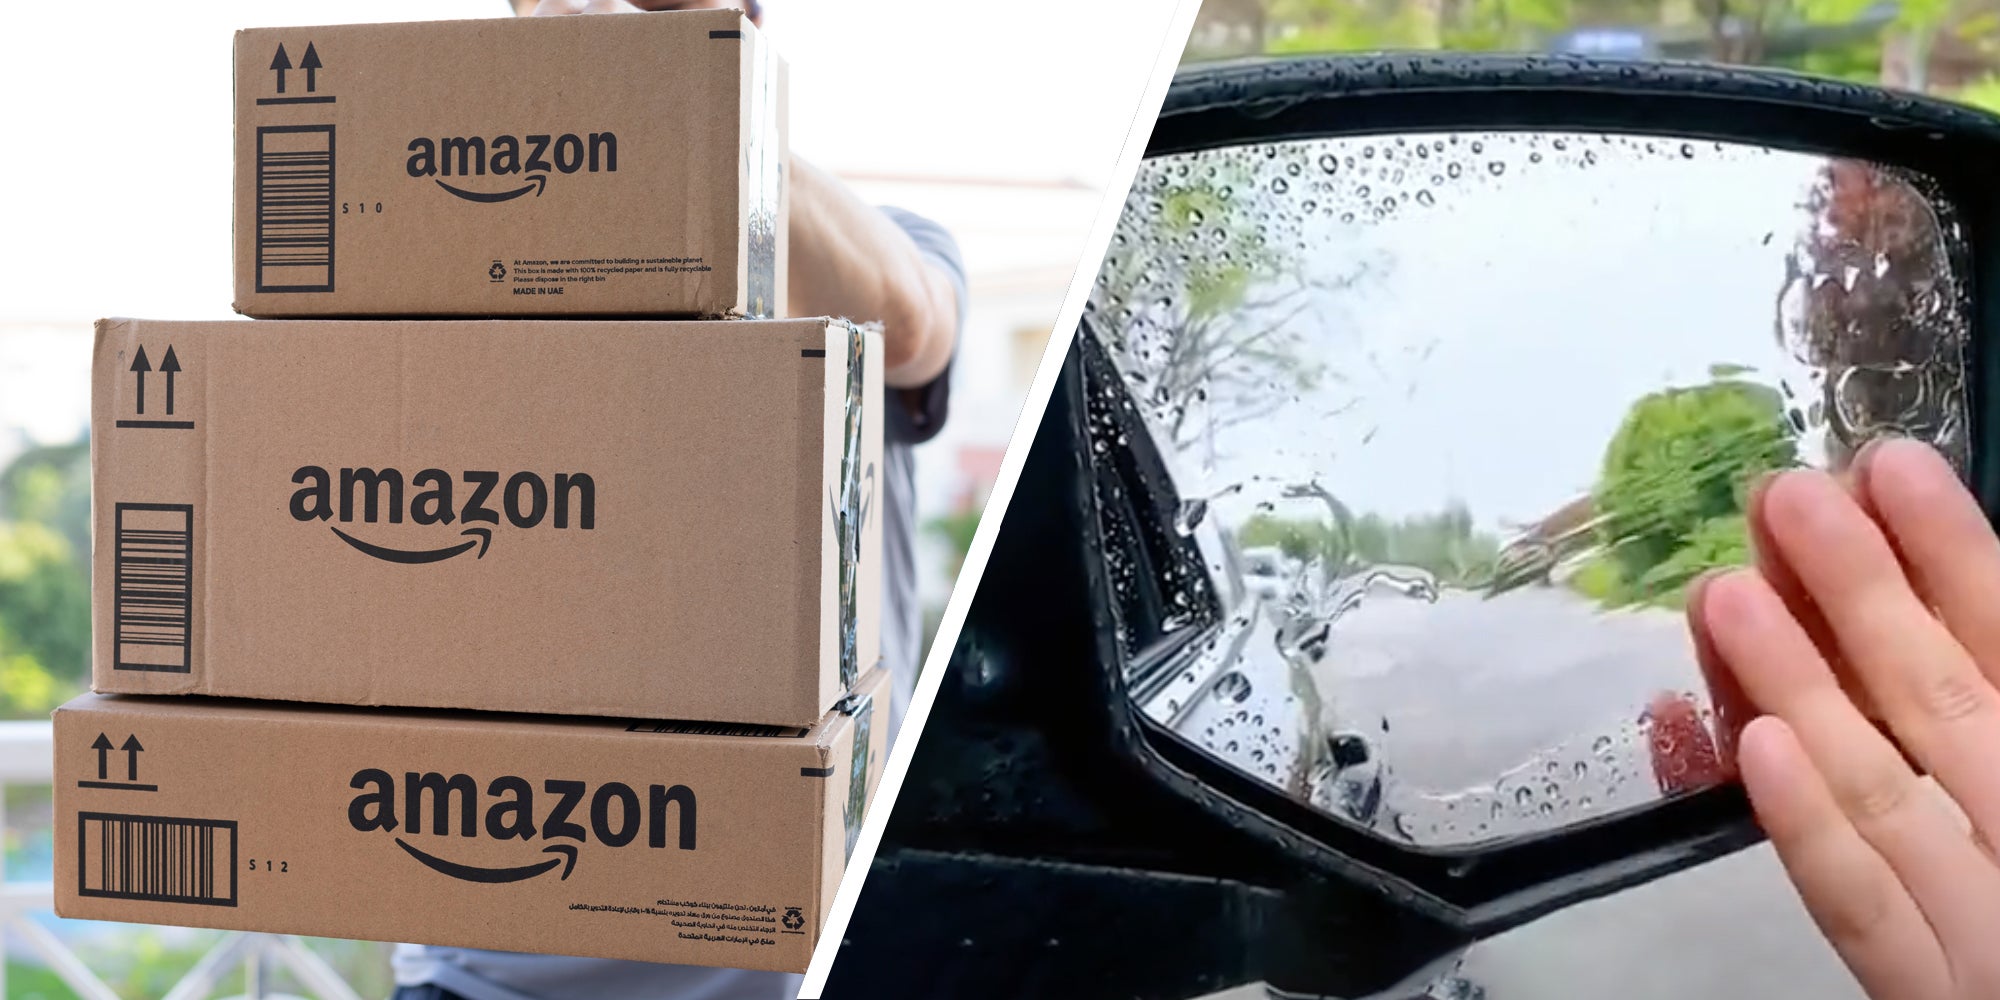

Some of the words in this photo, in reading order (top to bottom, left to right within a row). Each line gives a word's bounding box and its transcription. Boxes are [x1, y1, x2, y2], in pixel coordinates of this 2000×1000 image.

[406, 131, 618, 178] amazon
[614, 257, 640, 265] building
[682, 257, 703, 265] planet
[597, 266, 624, 274] recycled
[665, 266, 679, 274] fully
[680, 265, 712, 274] recyclable
[535, 276, 559, 284] dispose
[579, 275, 594, 283] right
[513, 287, 536, 295] MADE
[538, 287, 546, 295] IN
[548, 287, 564, 295] UAE
[289, 465, 596, 530] amazon
[347, 767, 697, 851] amazon
